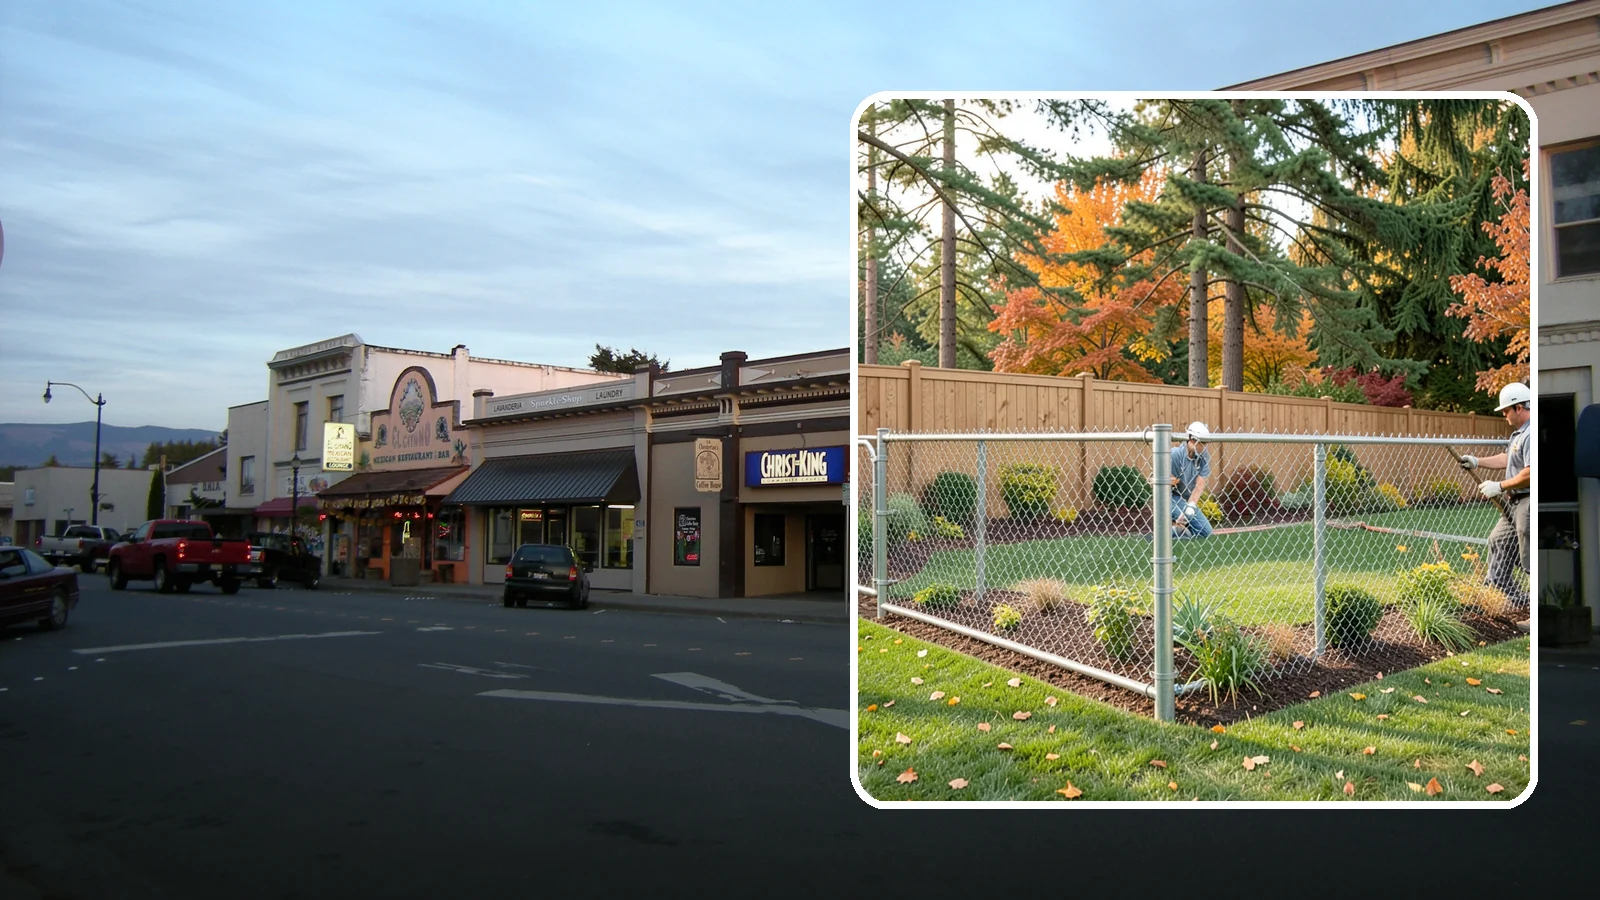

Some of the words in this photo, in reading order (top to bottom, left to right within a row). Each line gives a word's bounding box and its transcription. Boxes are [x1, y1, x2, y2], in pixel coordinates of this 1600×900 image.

[596, 389, 623, 399] LAUNDRY
[398, 451, 433, 462] RESTAURANT
[438, 450, 450, 458] BAR
[761, 452, 797, 478] CHRIST
[799, 450, 827, 476] KING
